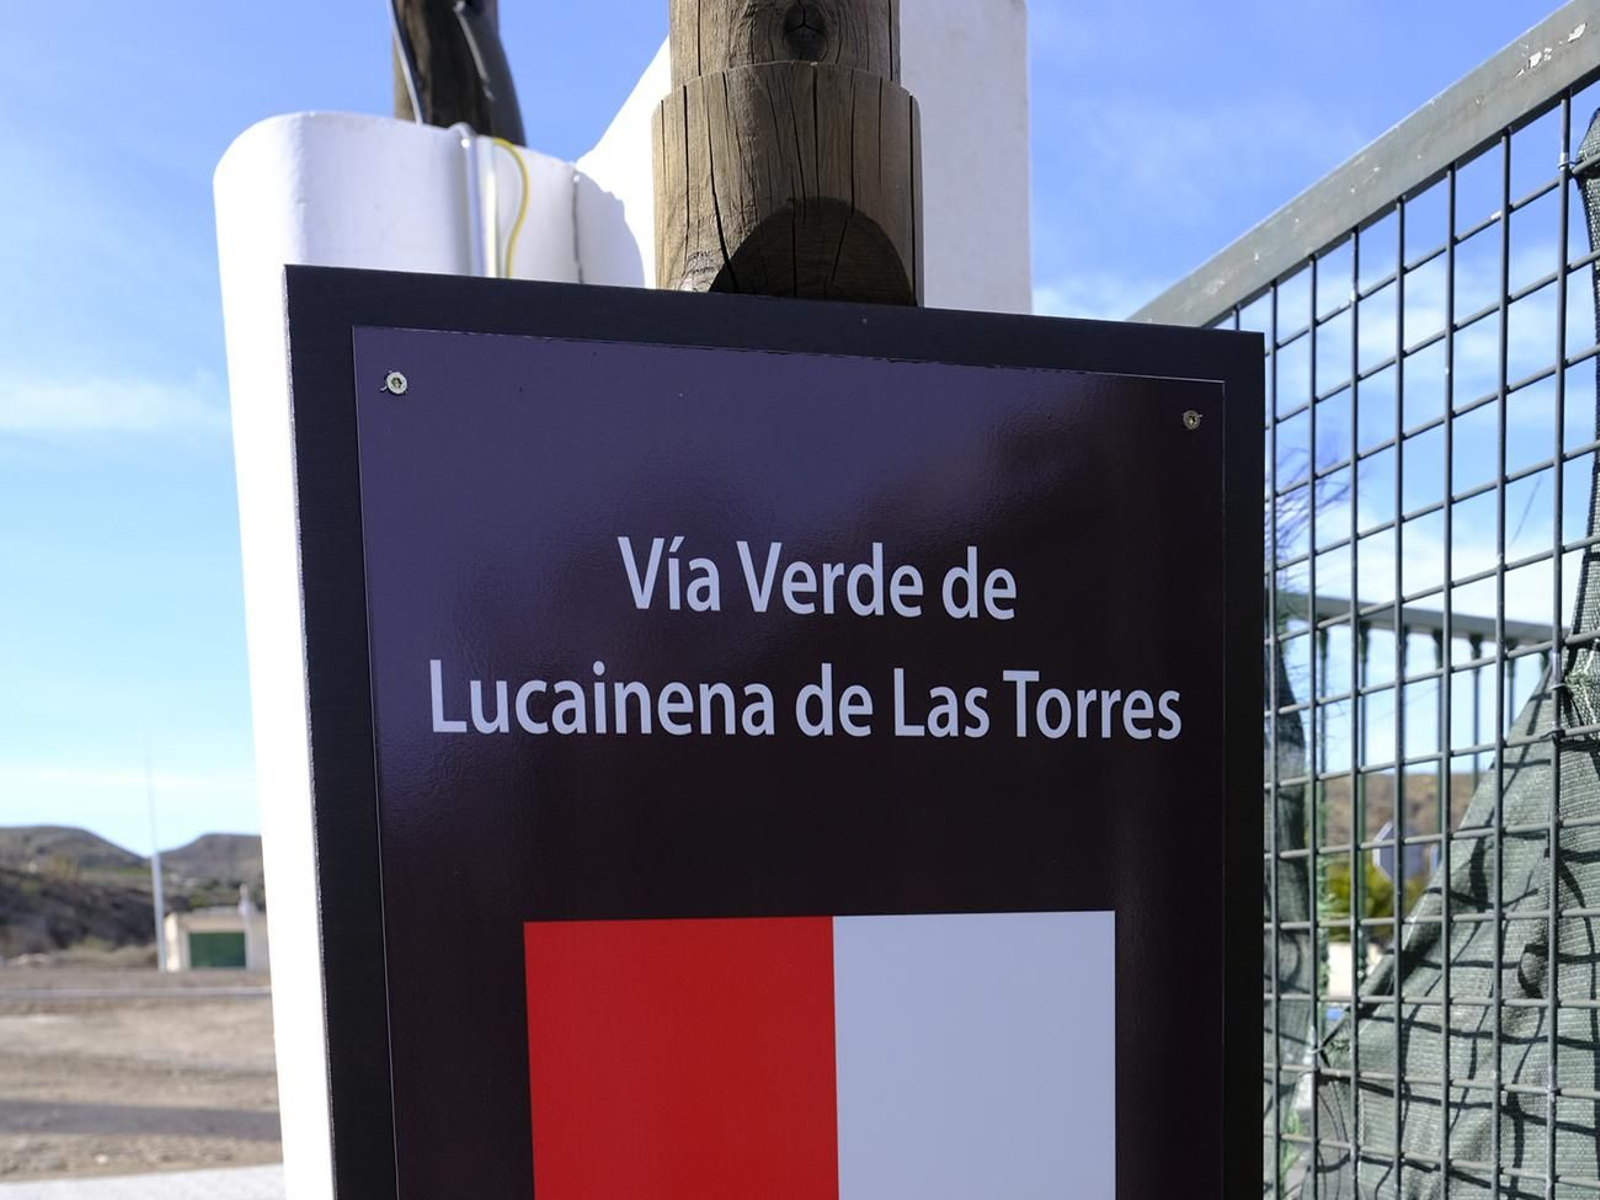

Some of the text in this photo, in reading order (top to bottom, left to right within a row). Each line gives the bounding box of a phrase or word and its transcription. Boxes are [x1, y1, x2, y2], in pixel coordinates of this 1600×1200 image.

[617, 535, 1016, 620] Vía Verde de
[429, 659, 1182, 740] Lucainena de Las Torres
